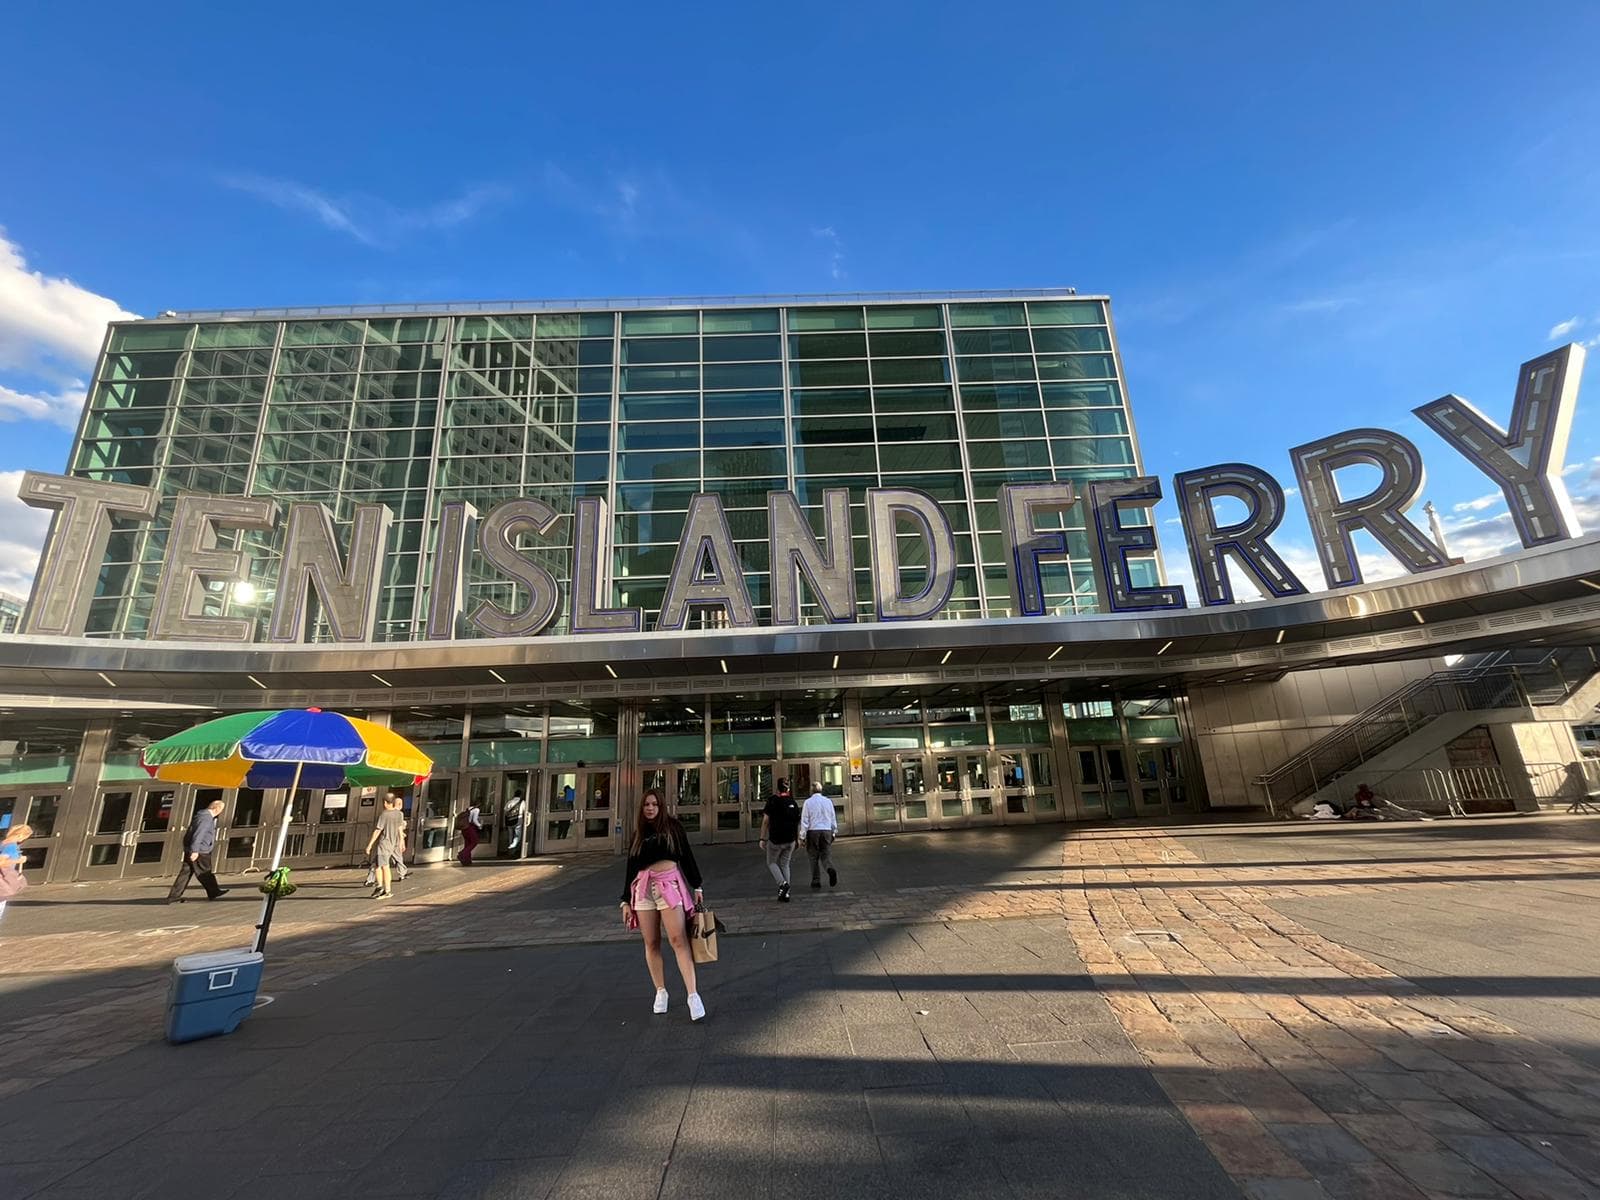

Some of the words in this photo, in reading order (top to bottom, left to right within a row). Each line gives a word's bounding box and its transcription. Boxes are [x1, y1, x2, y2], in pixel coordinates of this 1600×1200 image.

[18, 471, 394, 642] TEN
[429, 487, 955, 638] ISLAND
[1000, 342, 1587, 617] FERRY
